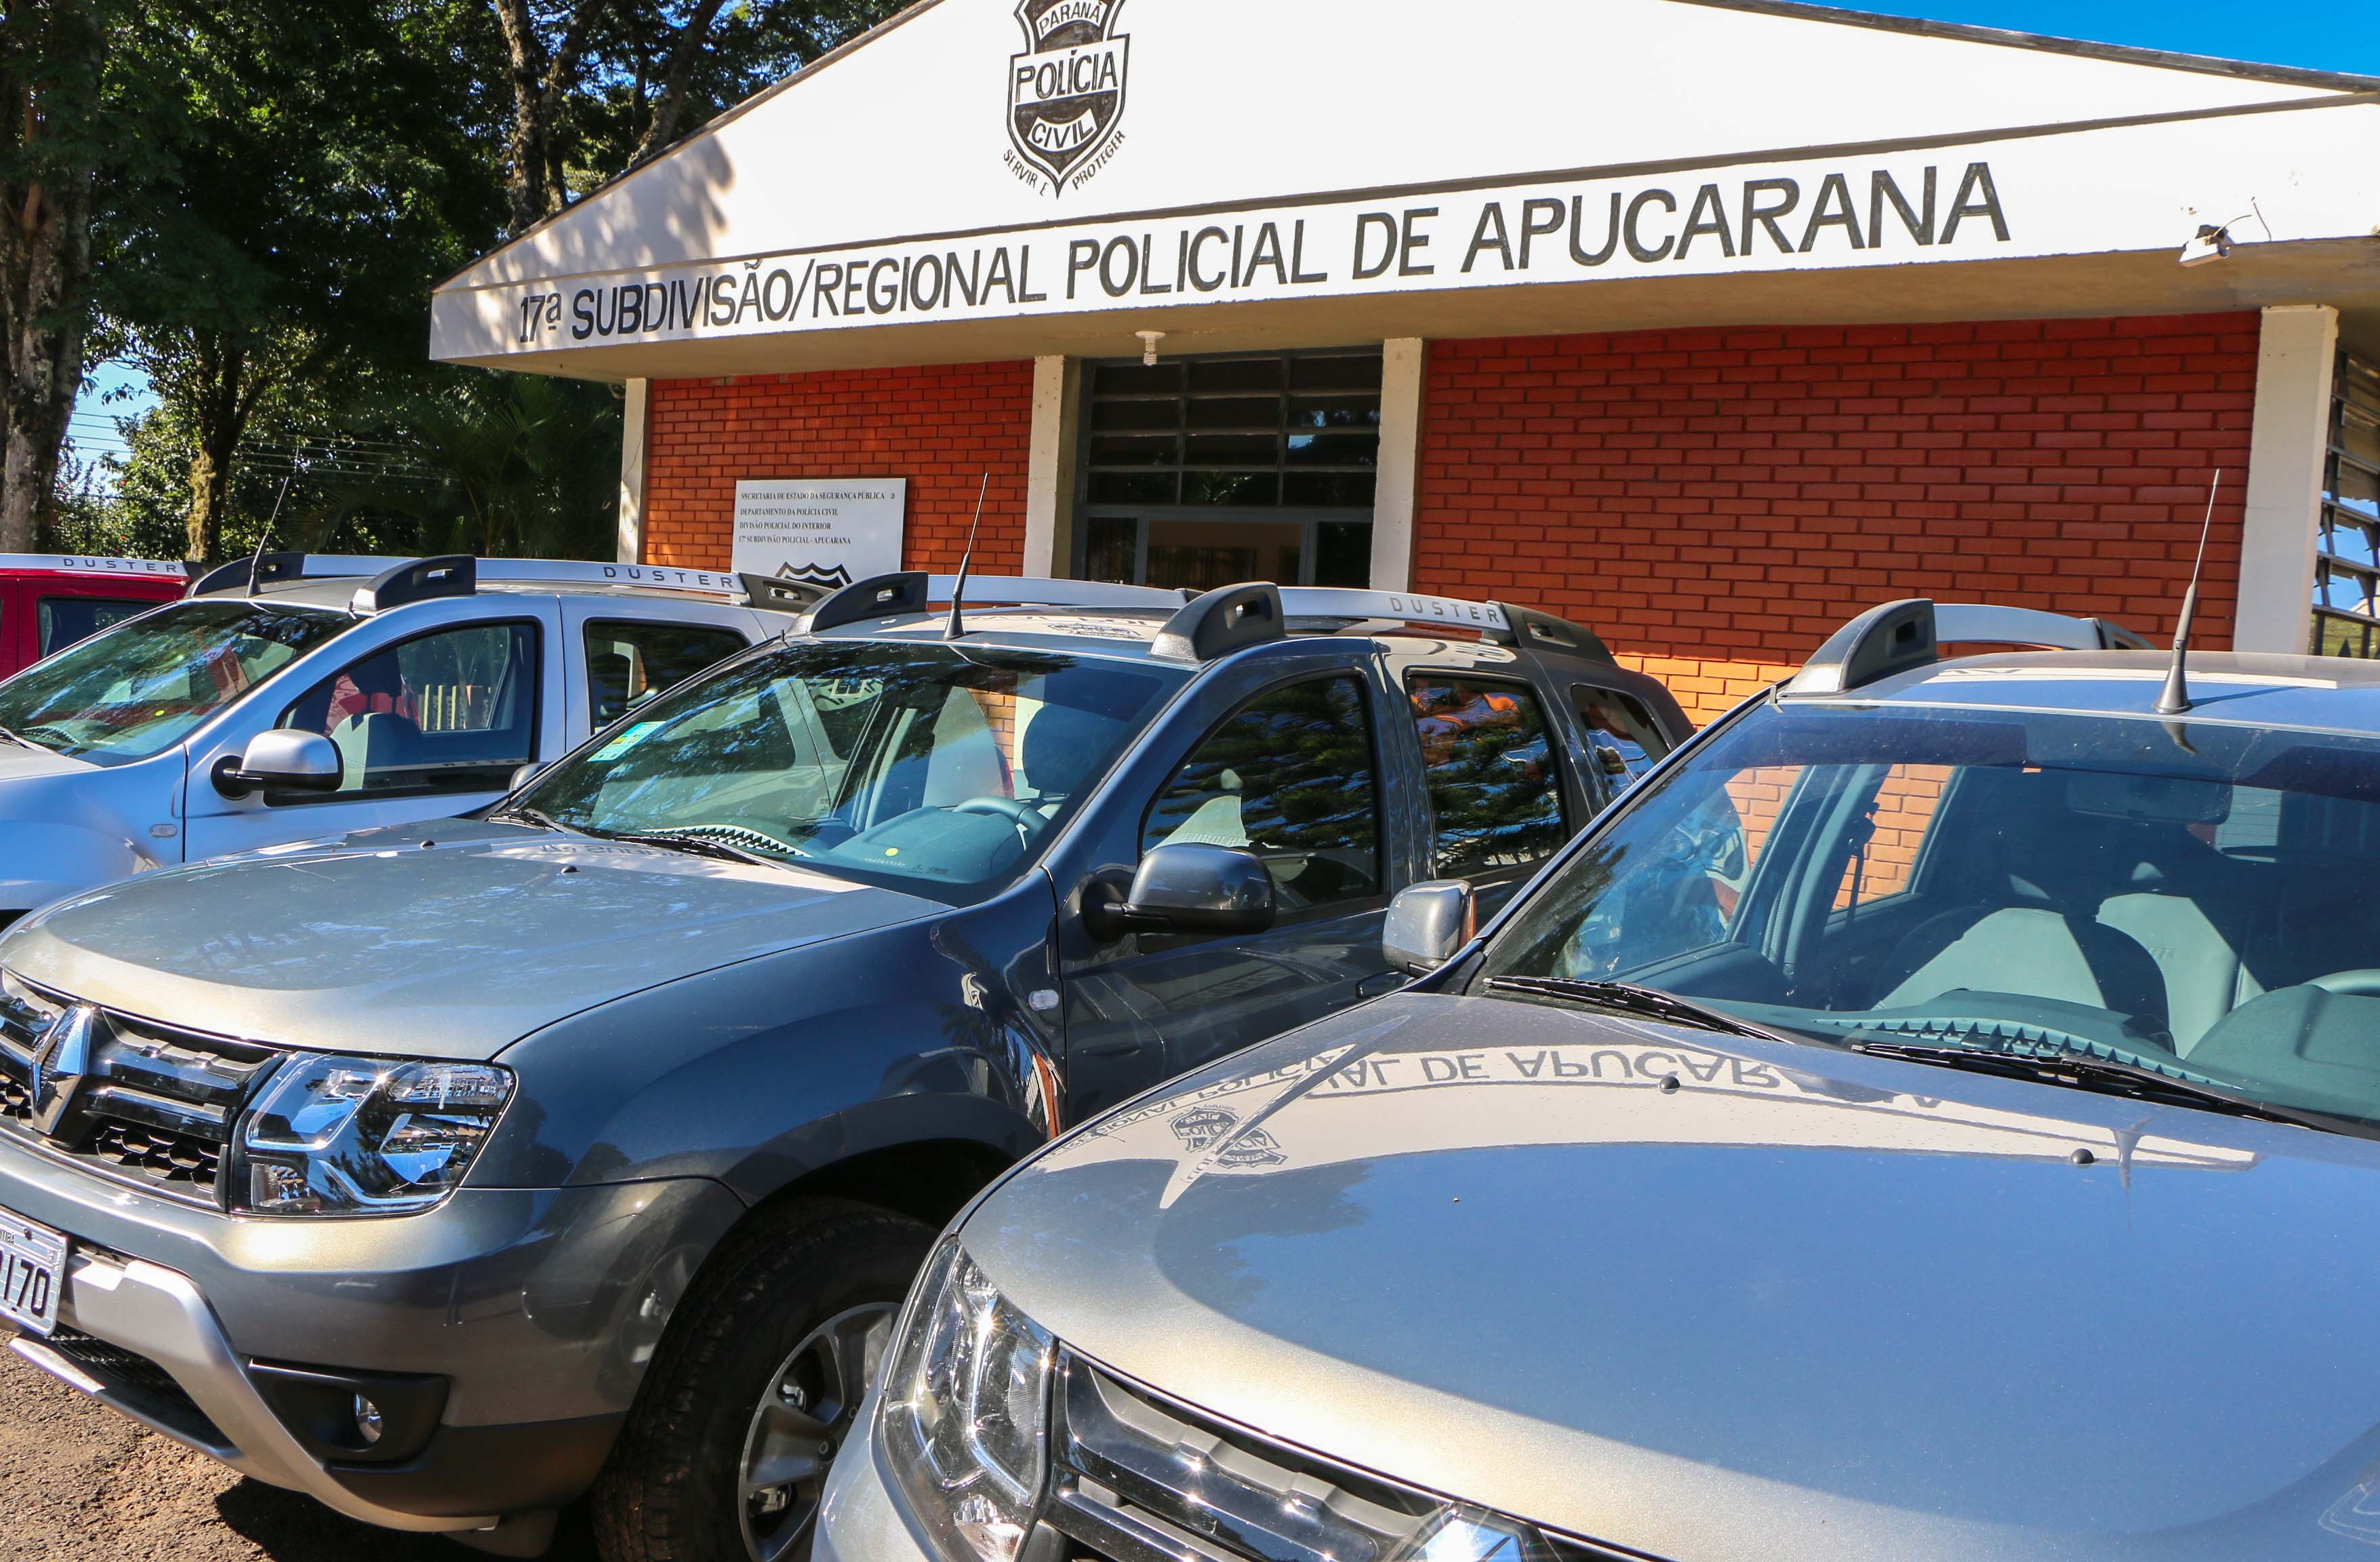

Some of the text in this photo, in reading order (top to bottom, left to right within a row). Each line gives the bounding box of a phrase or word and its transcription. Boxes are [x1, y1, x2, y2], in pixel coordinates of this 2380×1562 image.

[1039, 1, 1102, 35] PARANÁ
[1015, 49, 1118, 103] POLÍCIA
[1031, 120, 1093, 148] CIVIL
[1003, 130, 1126, 197] SERVIR E PROTEGER
[571, 245, 1047, 340] SUBDIVISÃO/REGIONAL
[1066, 219, 1327, 300] POLICIAL
[1352, 207, 1439, 280] DE
[1459, 162, 2011, 273] APUCARANA
[819, 492, 856, 501] SEGURANÇA
[858, 489, 885, 500] PÚBLICA
[796, 506, 820, 515] POLÍCIA
[740, 520, 763, 529] DIVISÃO
[747, 534, 781, 543] SUBDIVISÃO
[814, 536, 851, 544] APUCARANA
[63, 558, 177, 572] DUSTER
[603, 566, 733, 588] DUSTER
[1390, 597, 1499, 623] DUSTER
